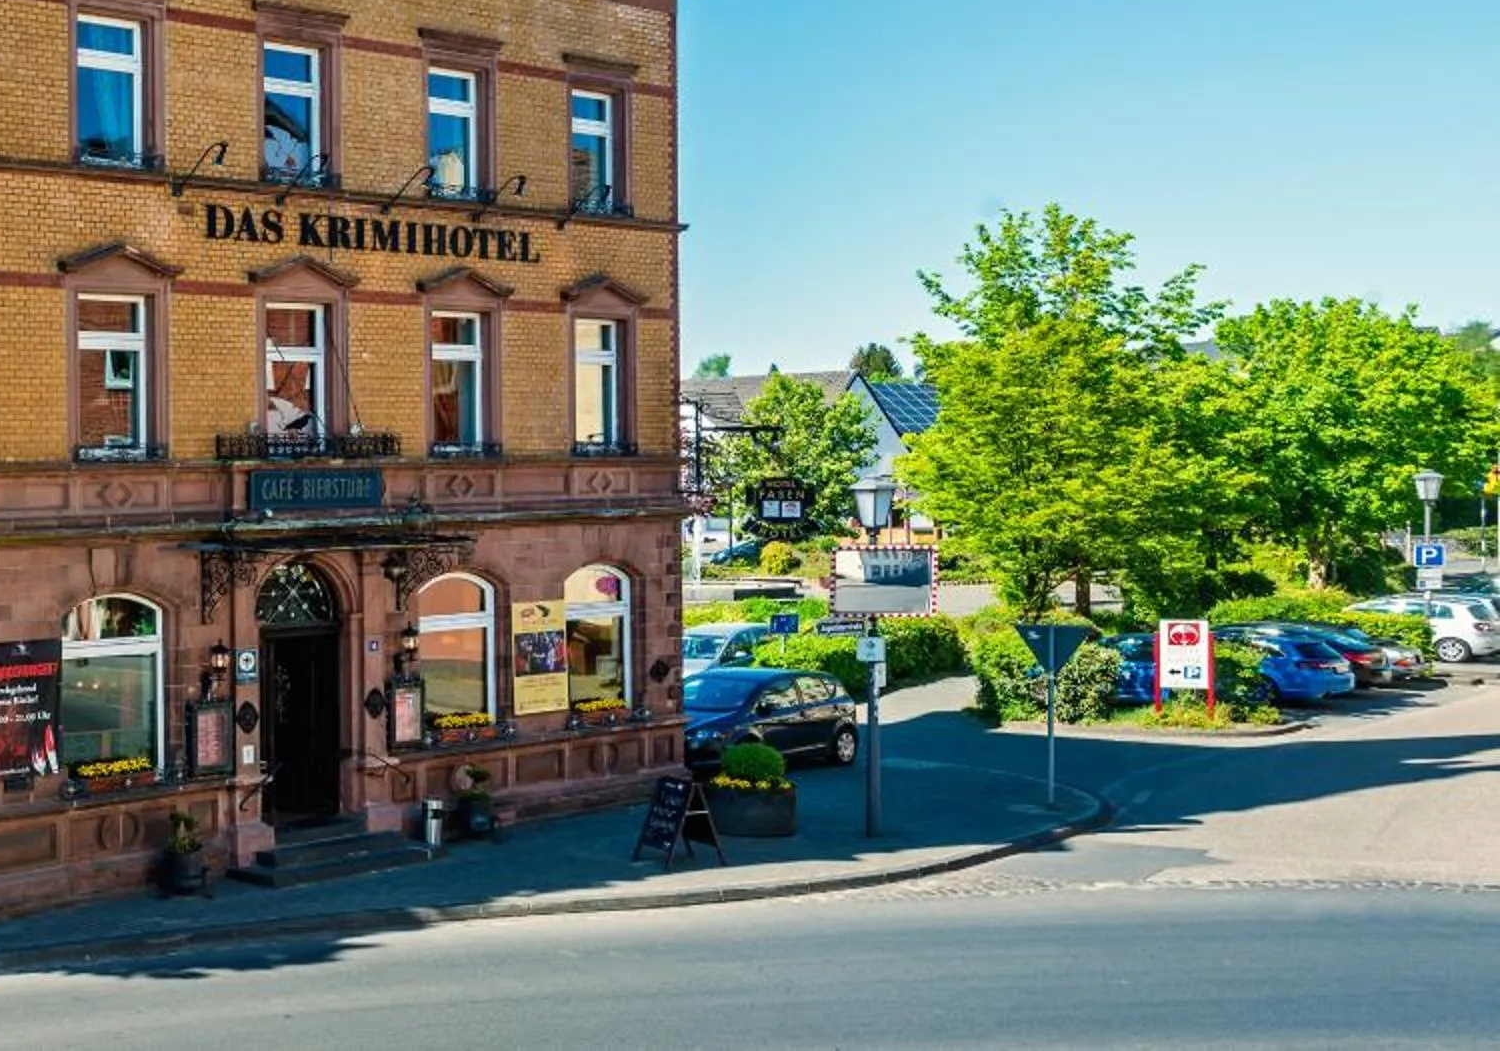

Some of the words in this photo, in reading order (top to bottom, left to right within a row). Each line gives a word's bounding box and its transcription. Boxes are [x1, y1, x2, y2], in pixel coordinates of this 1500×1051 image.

[205, 203, 284, 243] DAS
[300, 212, 541, 264] KRIMIHOTEL
[1421, 548, 1438, 564] P
